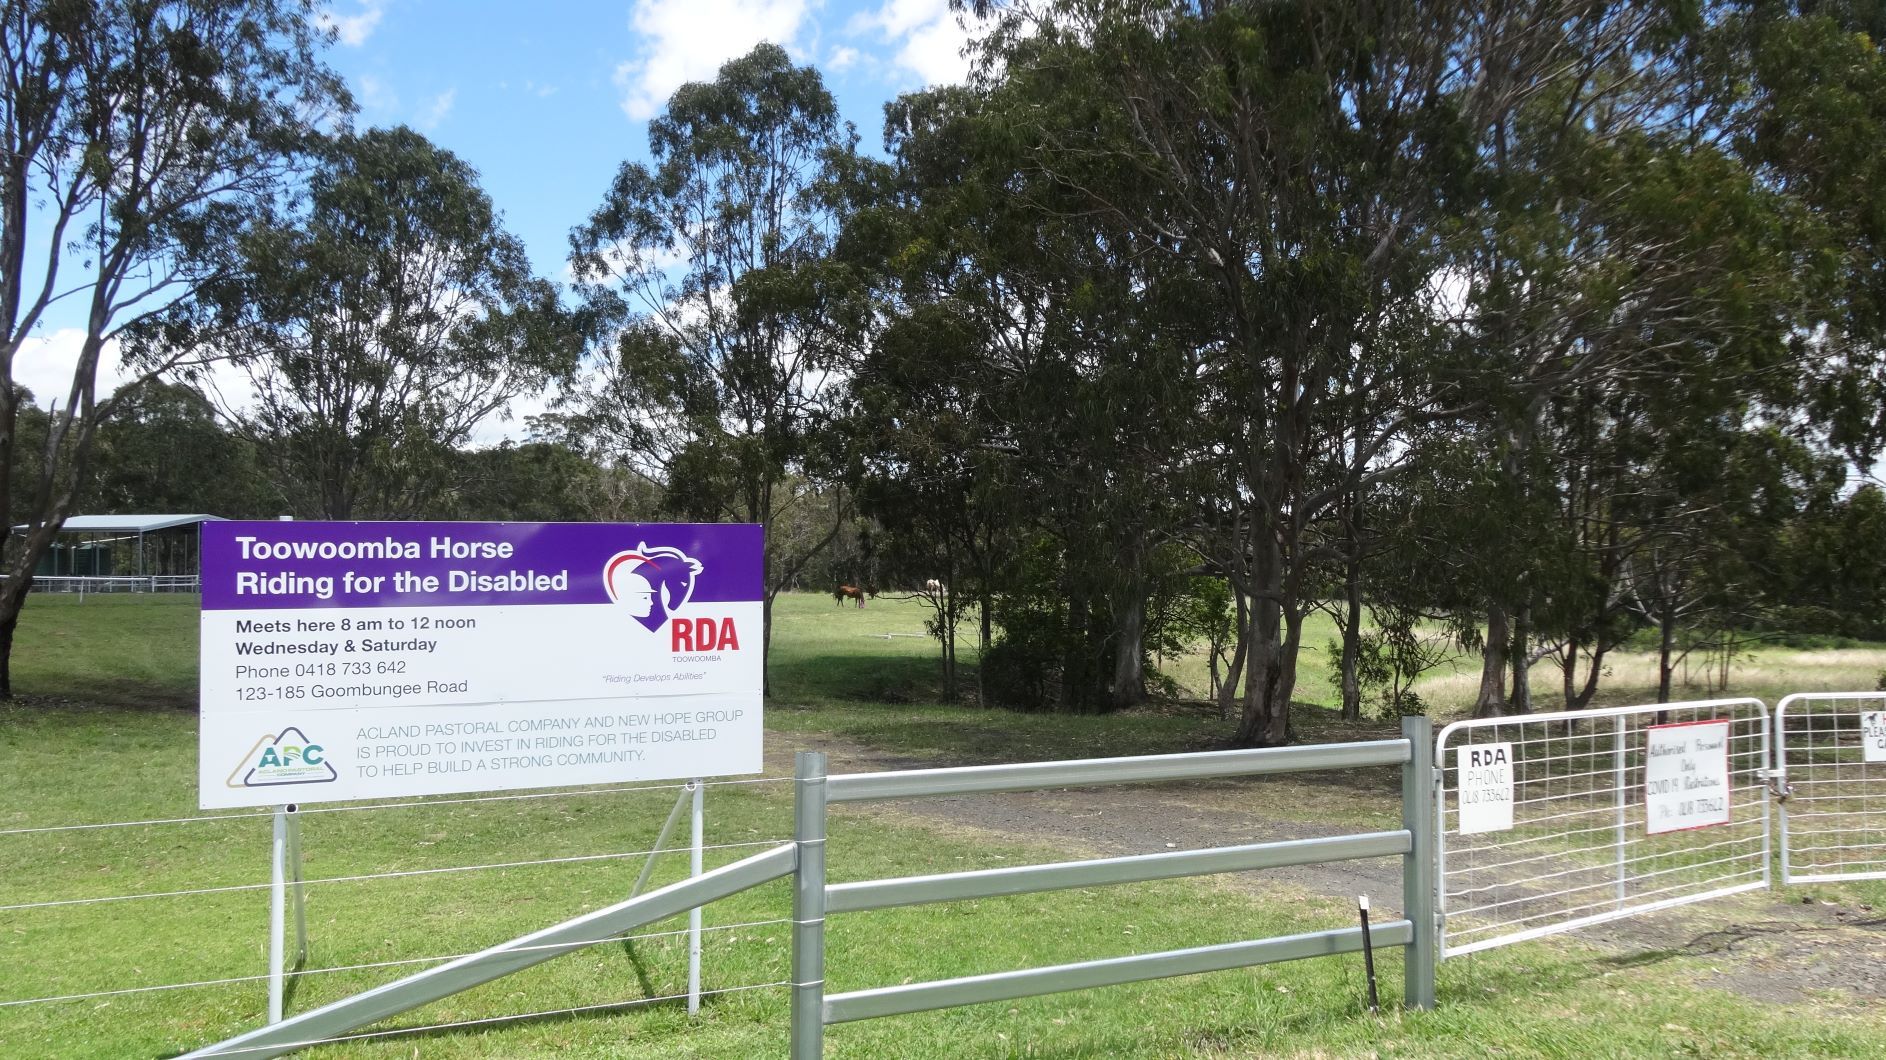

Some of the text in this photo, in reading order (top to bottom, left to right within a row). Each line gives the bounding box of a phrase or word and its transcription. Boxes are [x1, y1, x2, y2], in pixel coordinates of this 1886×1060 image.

[236, 536, 514, 559] Toowoomba Horse
[236, 570, 568, 599] Riding for the Disabled
[236, 617, 476, 633] Meets here 8 am to 12 noon
[672, 617, 739, 652] RDA
[236, 638, 437, 656] Wednesday & Saturday
[236, 661, 406, 678] Phone 0418 733 642
[634, 673, 671, 682] Develops
[236, 680, 468, 700] 123-185 Goombungee Road
[357, 710, 743, 740] ACLAND PASTORAL COMPANY AND NEW HOPE GROUP
[357, 728, 716, 759] IS PROUD TO INVEST IN RIDING FOR THE DISABLED
[258, 745, 324, 767] APC
[356, 750, 645, 778] TO HELP BUILD A STRONG COMMUNITY.
[1471, 749, 1506, 767] RDA
[1467, 769, 1504, 786] PHONE
